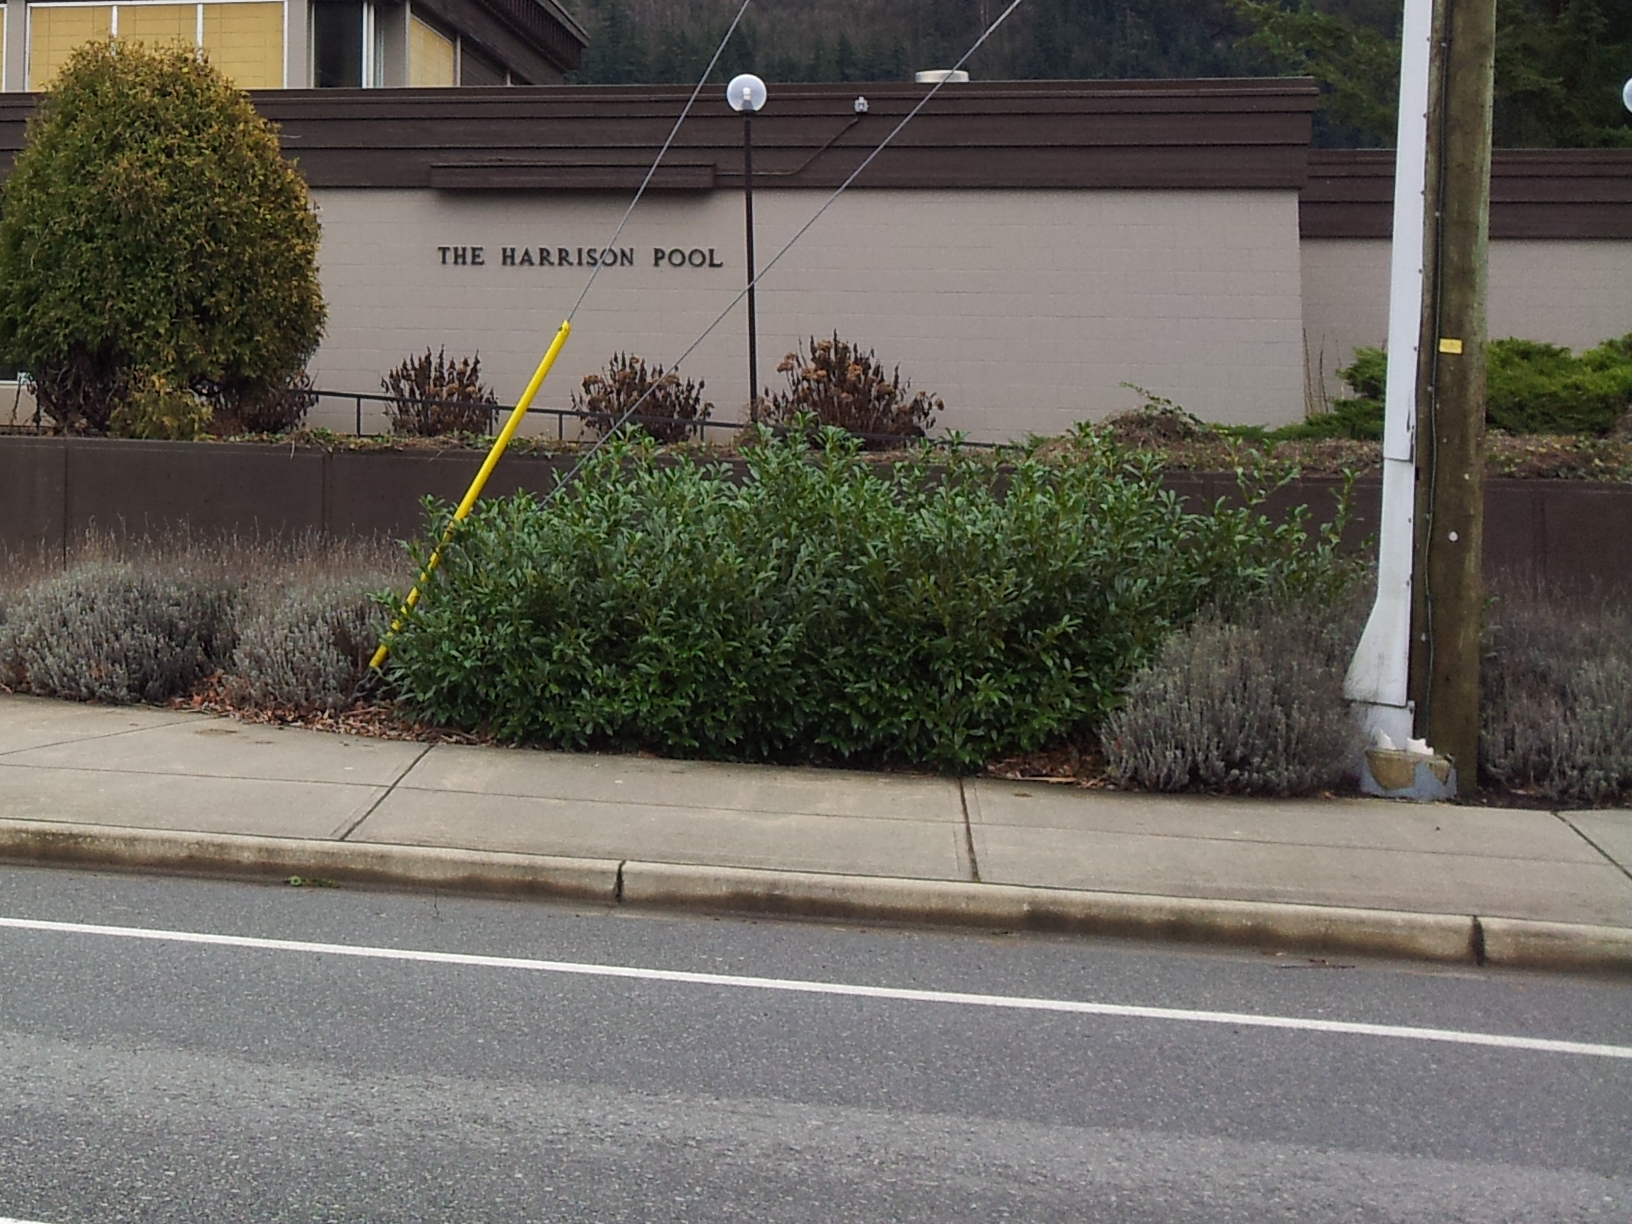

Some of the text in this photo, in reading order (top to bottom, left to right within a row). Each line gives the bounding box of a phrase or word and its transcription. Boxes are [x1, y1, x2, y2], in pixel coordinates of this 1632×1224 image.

[437, 246, 724, 268] THE HARRISON POOL
